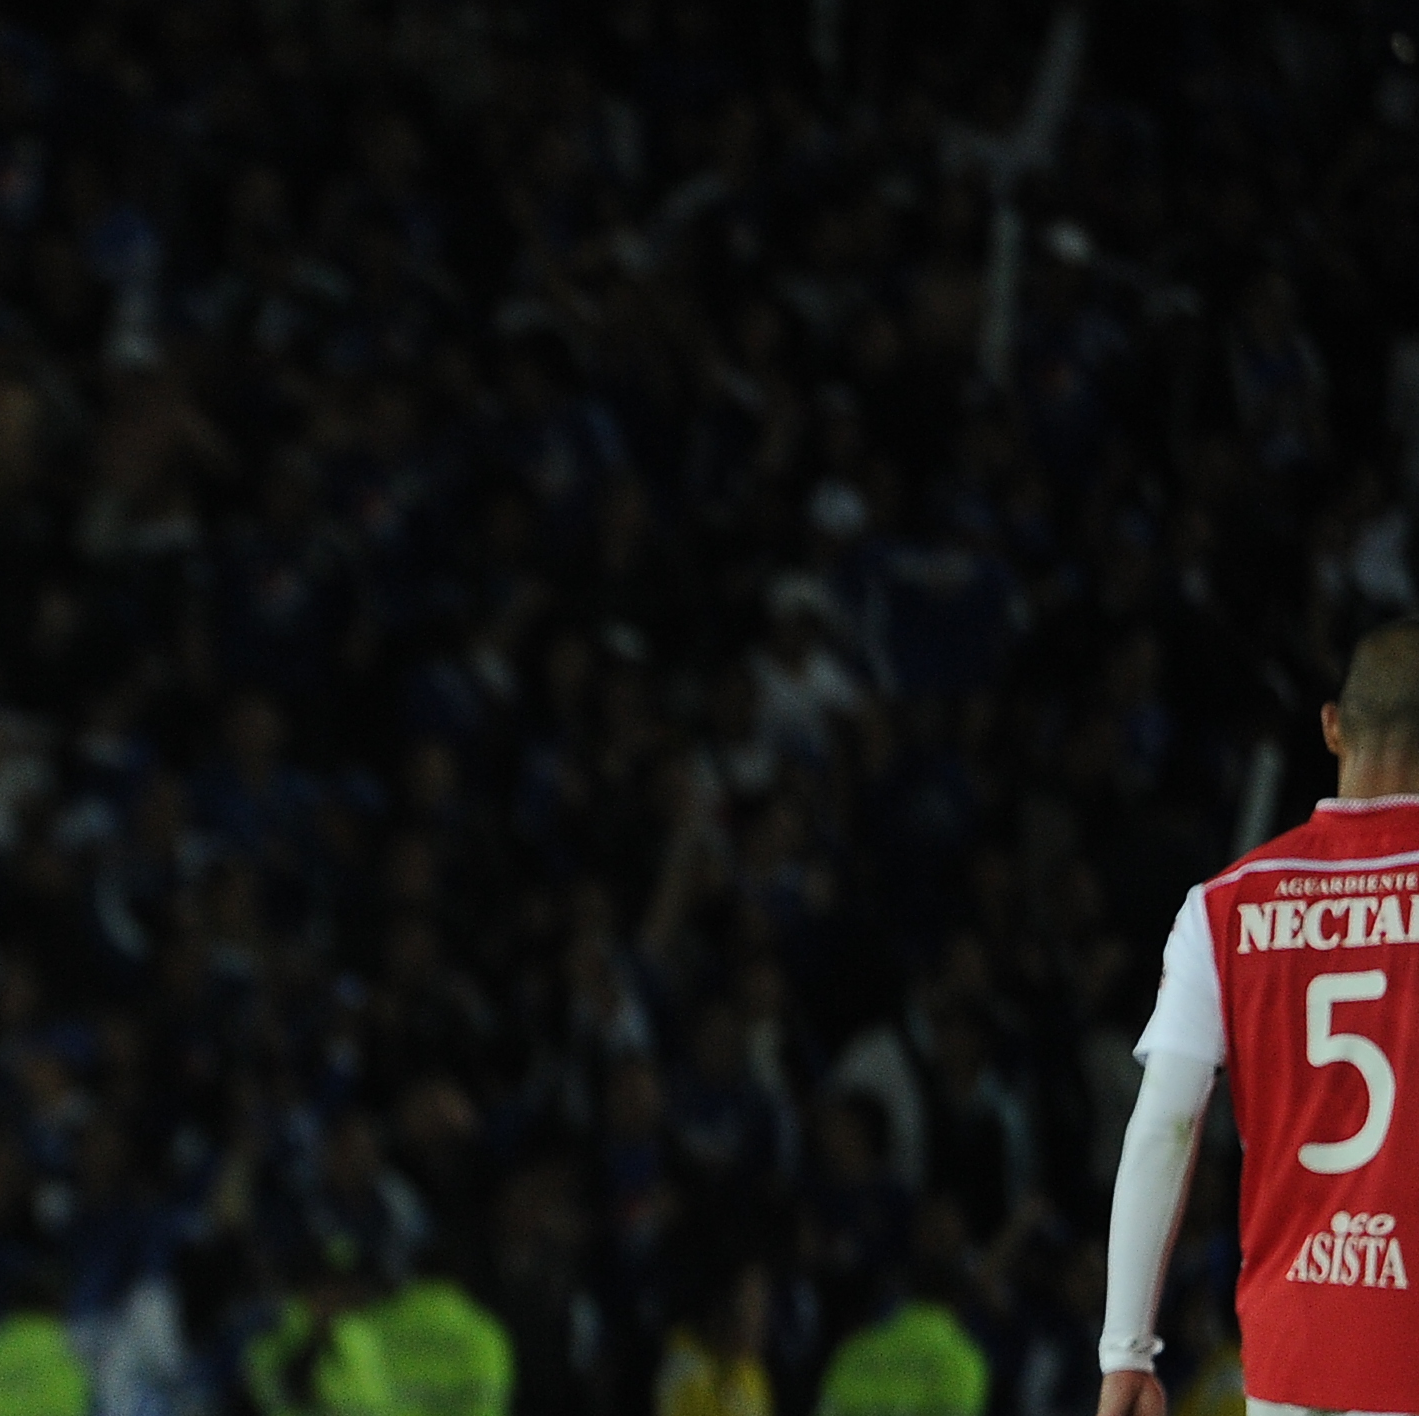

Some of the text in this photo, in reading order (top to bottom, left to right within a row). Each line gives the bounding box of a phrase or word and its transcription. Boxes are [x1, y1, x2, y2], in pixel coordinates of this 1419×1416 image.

[1237, 894, 1419, 955] NECTA
[1297, 969, 1396, 1175] 5
[1285, 1231, 1408, 1290] ASISTA
